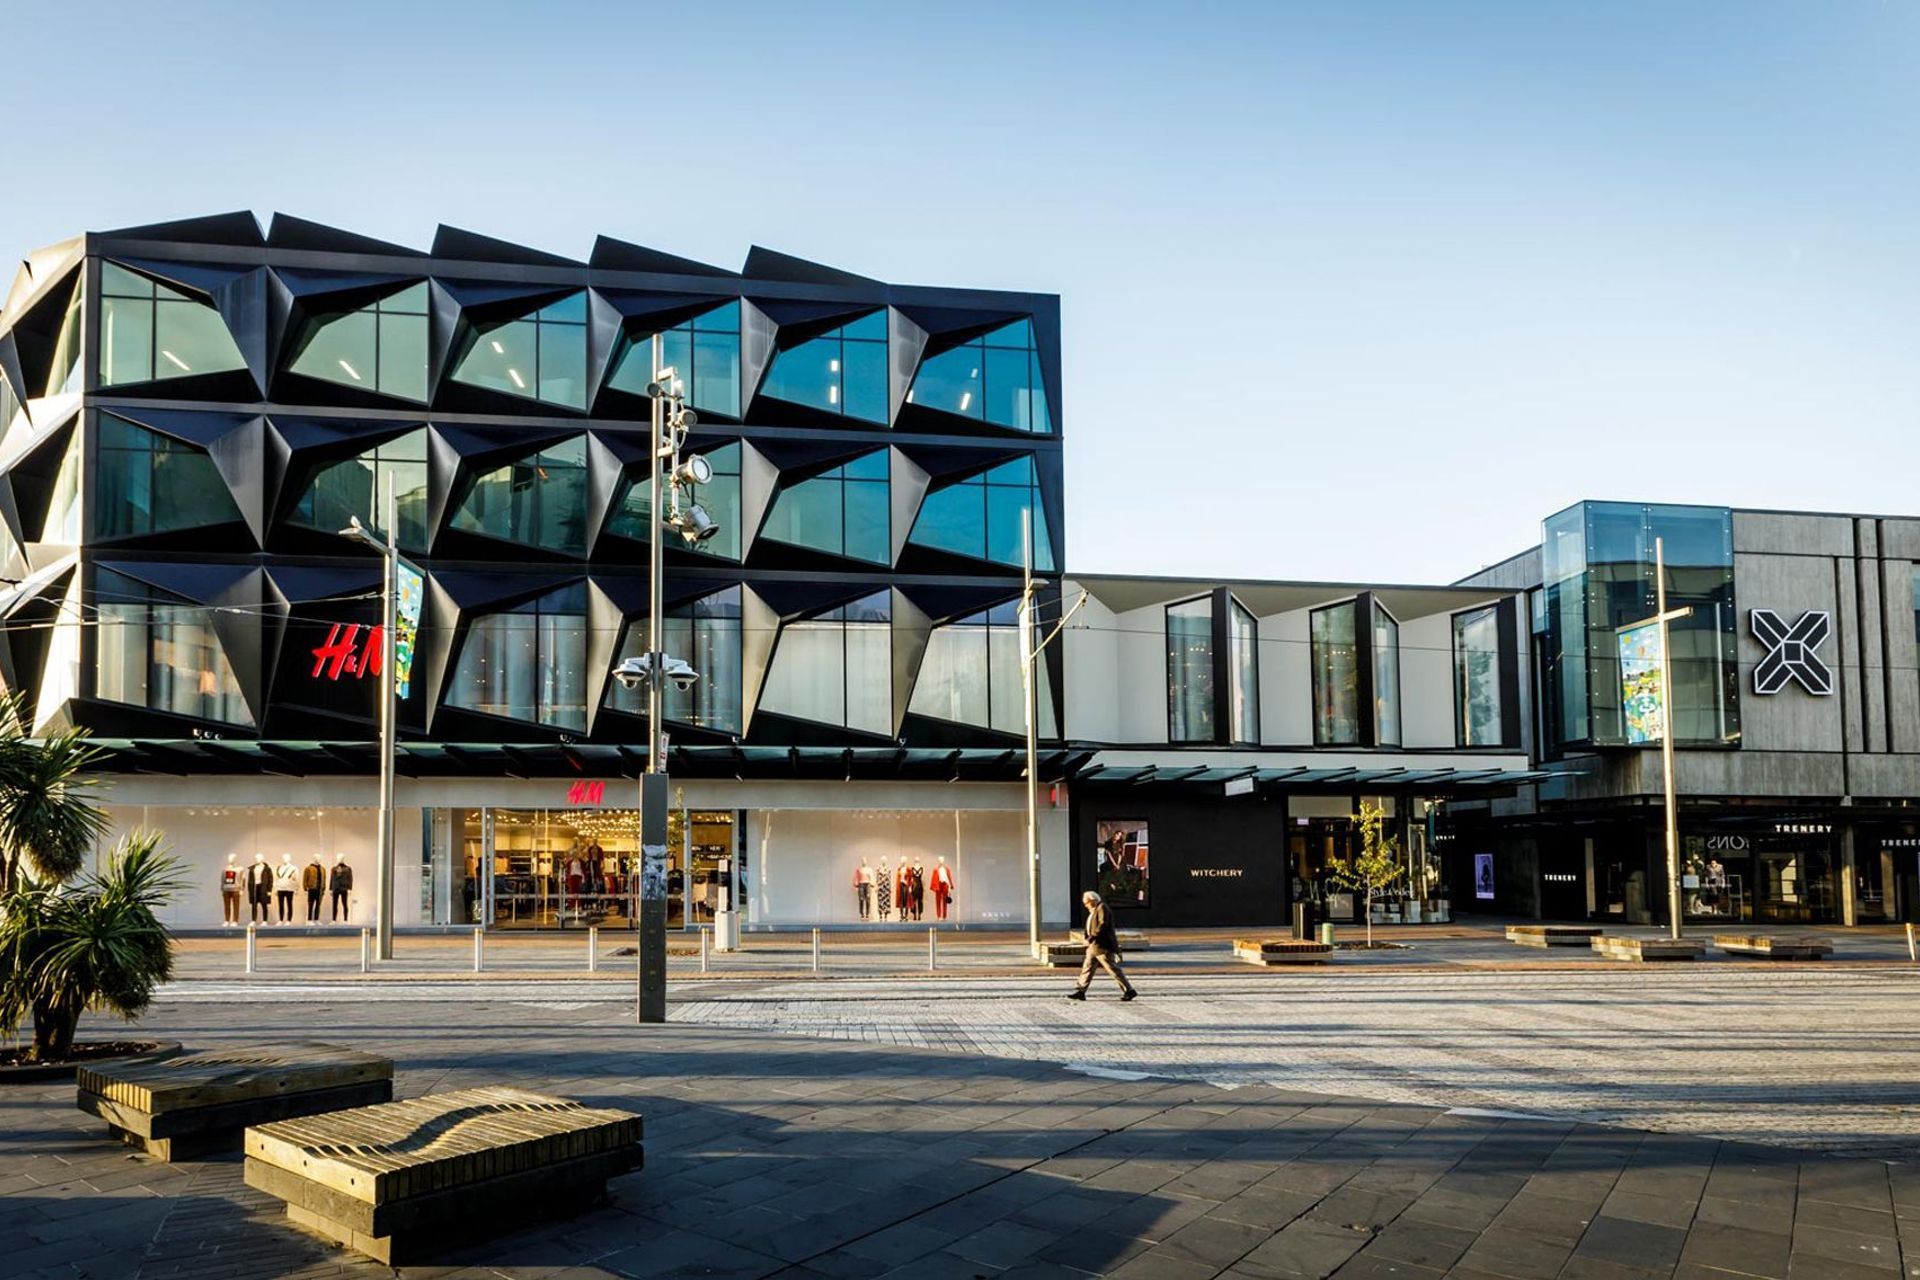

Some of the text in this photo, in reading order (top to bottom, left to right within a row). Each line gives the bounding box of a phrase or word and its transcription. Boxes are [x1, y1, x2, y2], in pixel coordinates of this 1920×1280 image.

[567, 781, 605, 806] HM
[1775, 824, 1832, 833] TRENERY
[1190, 869, 1243, 877] WITCHERY
